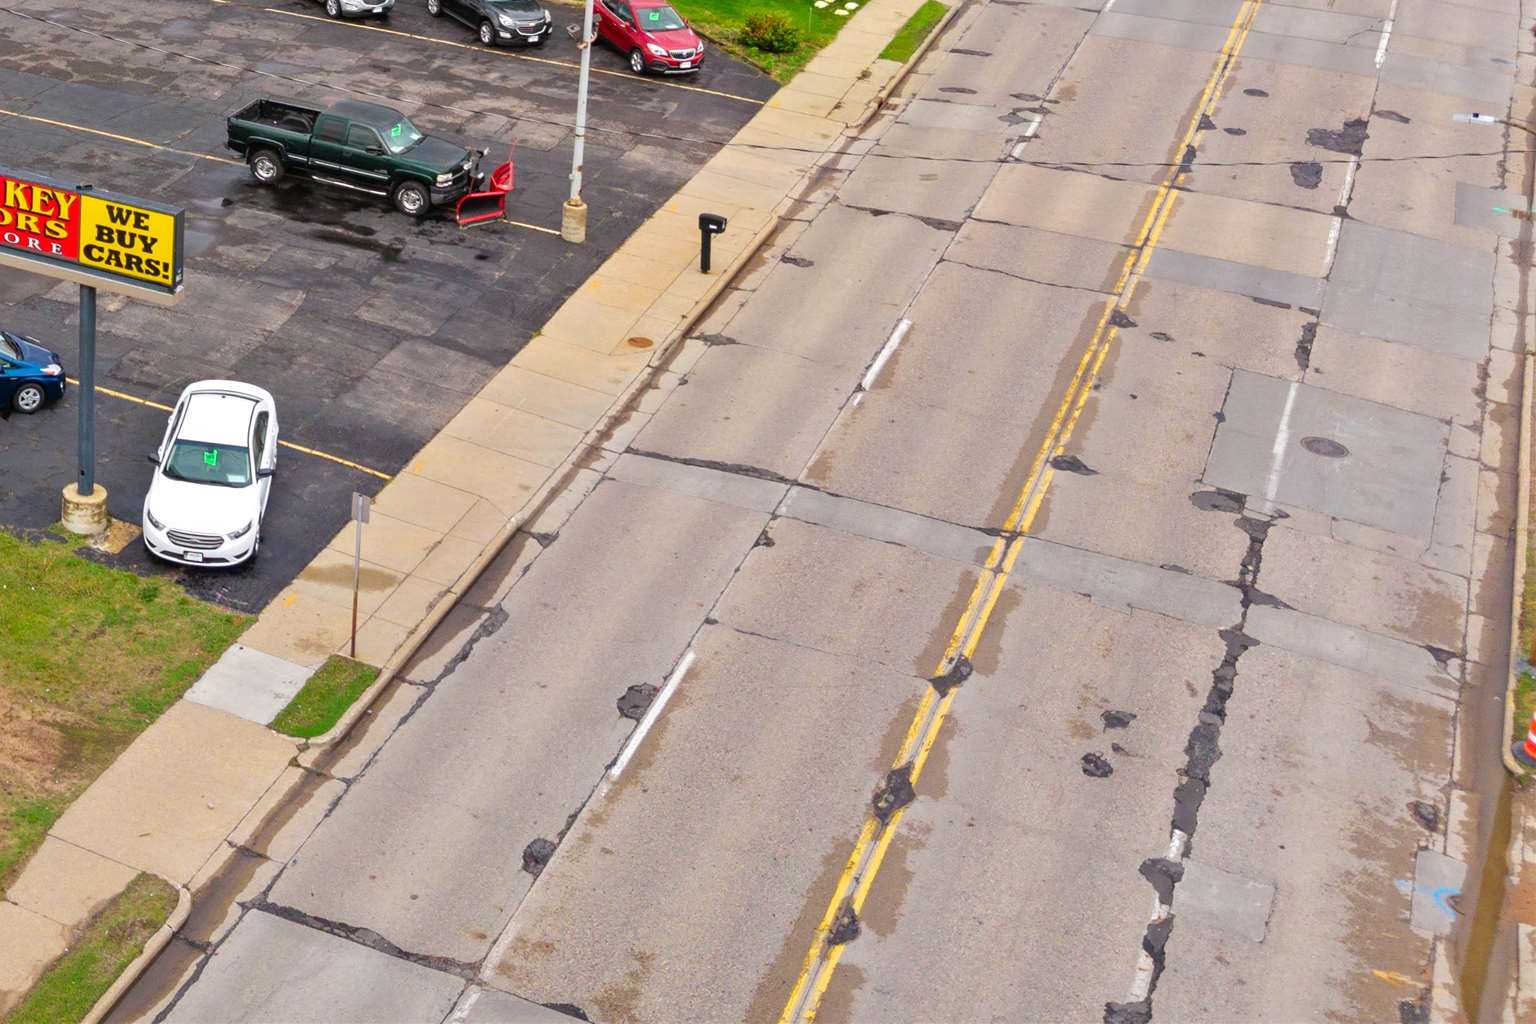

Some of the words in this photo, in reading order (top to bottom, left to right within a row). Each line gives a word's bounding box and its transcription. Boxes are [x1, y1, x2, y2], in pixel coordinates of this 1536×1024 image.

[5, 179, 77, 221] KEY
[106, 204, 151, 232] WE
[95, 224, 159, 254] BUY
[83, 244, 170, 280] CARS!
